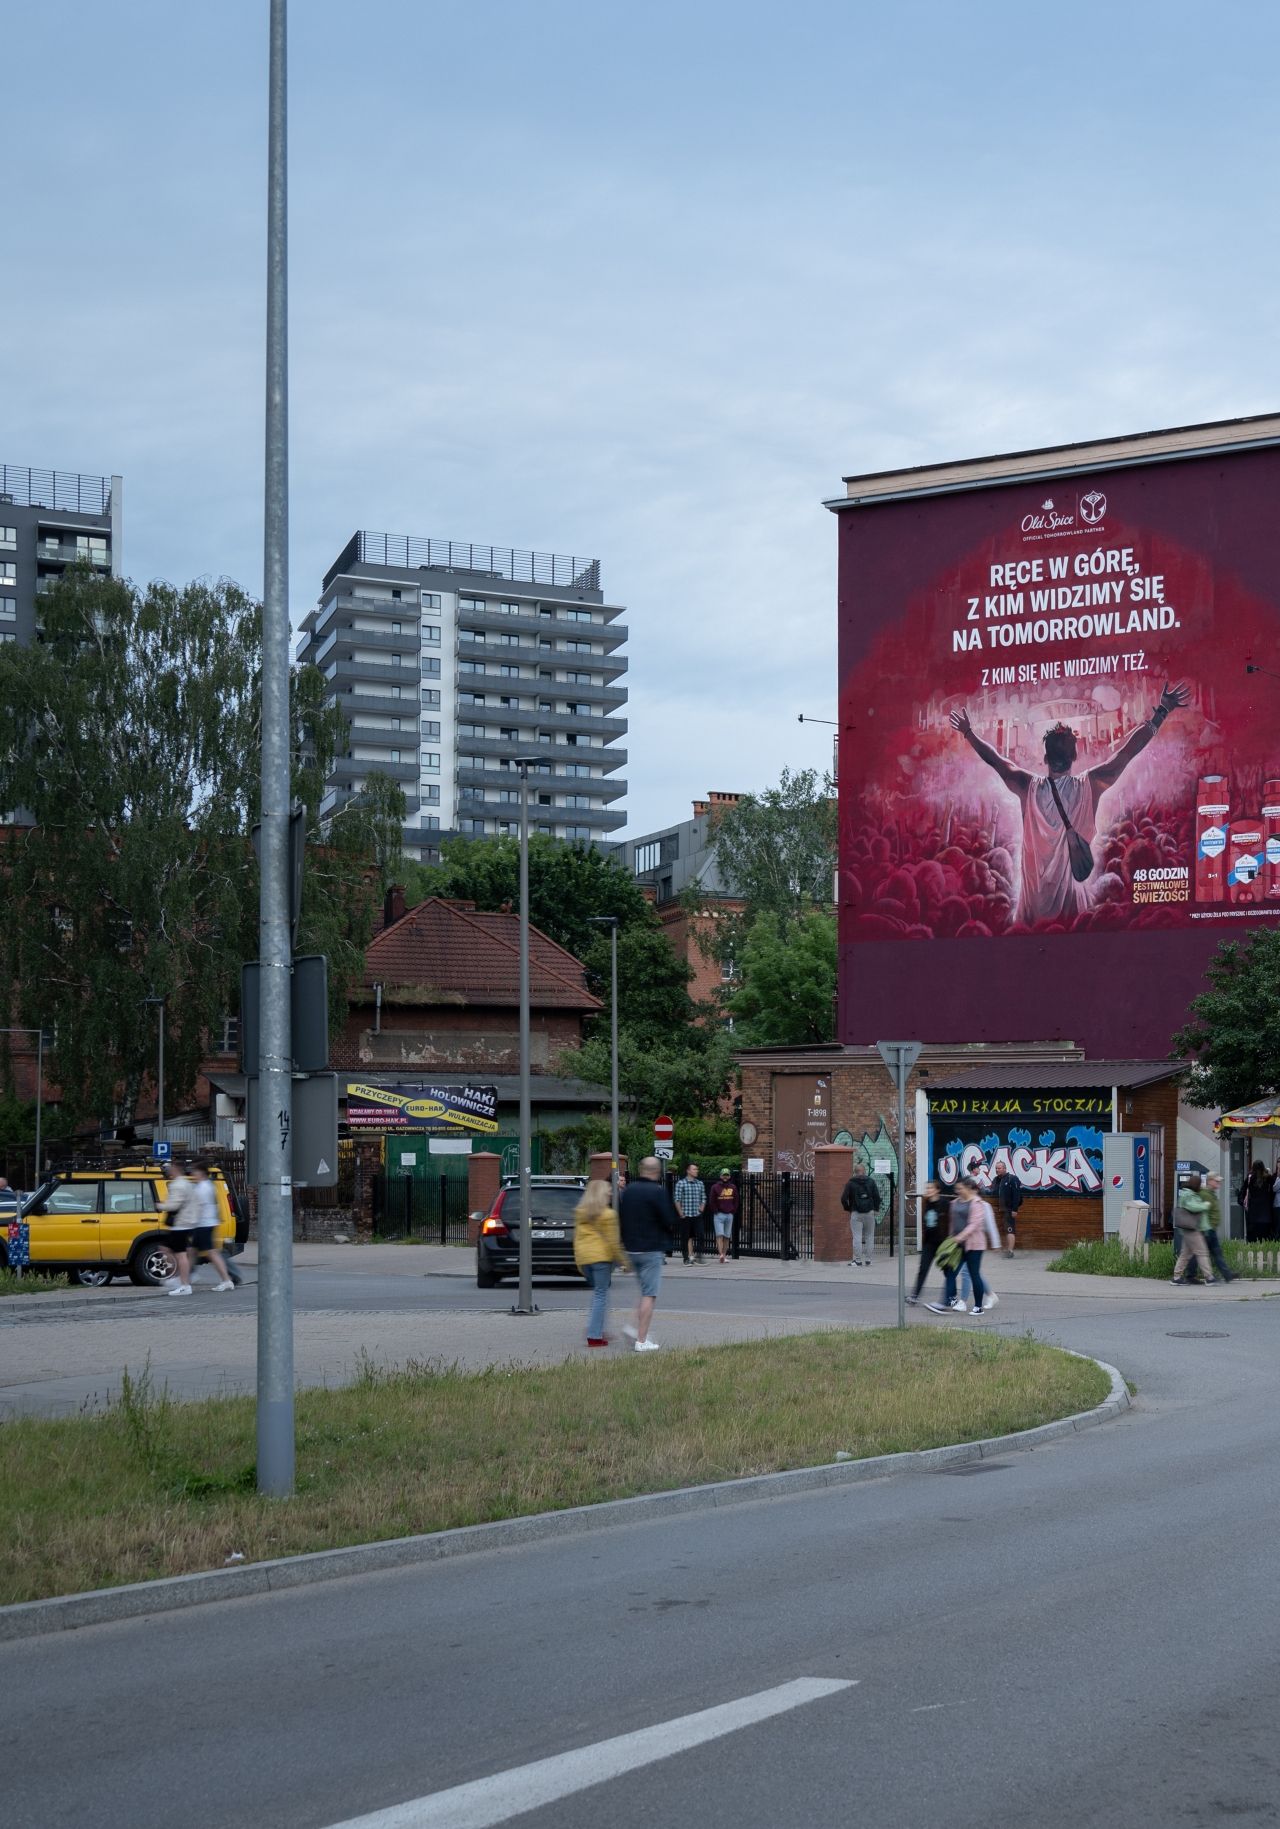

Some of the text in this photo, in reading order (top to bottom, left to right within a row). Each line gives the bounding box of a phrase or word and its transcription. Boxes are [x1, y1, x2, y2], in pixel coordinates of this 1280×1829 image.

[1021, 511, 1074, 532] Old Spice
[1022, 526, 1105, 542] OFFICIAL TOMORROWLAND PARTNER
[990, 547, 1140, 590] RĘCE W GÓRĘ,
[967, 575, 1165, 620] Z KIM WIDZIMY SIĘ
[953, 606, 1181, 652] NA TOMORROWLAND.
[981, 650, 1149, 686] Z KIM SIĘ NIE WIDZIMY TEŻ.
[1133, 867, 1188, 881] 48 GODZIN
[1133, 880, 1189, 890] FESTIWALOWEJ
[355, 1086, 403, 1104] PRZYCZEPY
[430, 1087, 495, 1117] HOLOWNICZE
[464, 1087, 495, 1106] HAKI
[448, 1111, 496, 1130] WULKANIZACJA
[157, 1143, 168, 1155] P
[960, 1143, 1103, 1193] GACKA
[1138, 1161, 1146, 1199] pepsi
